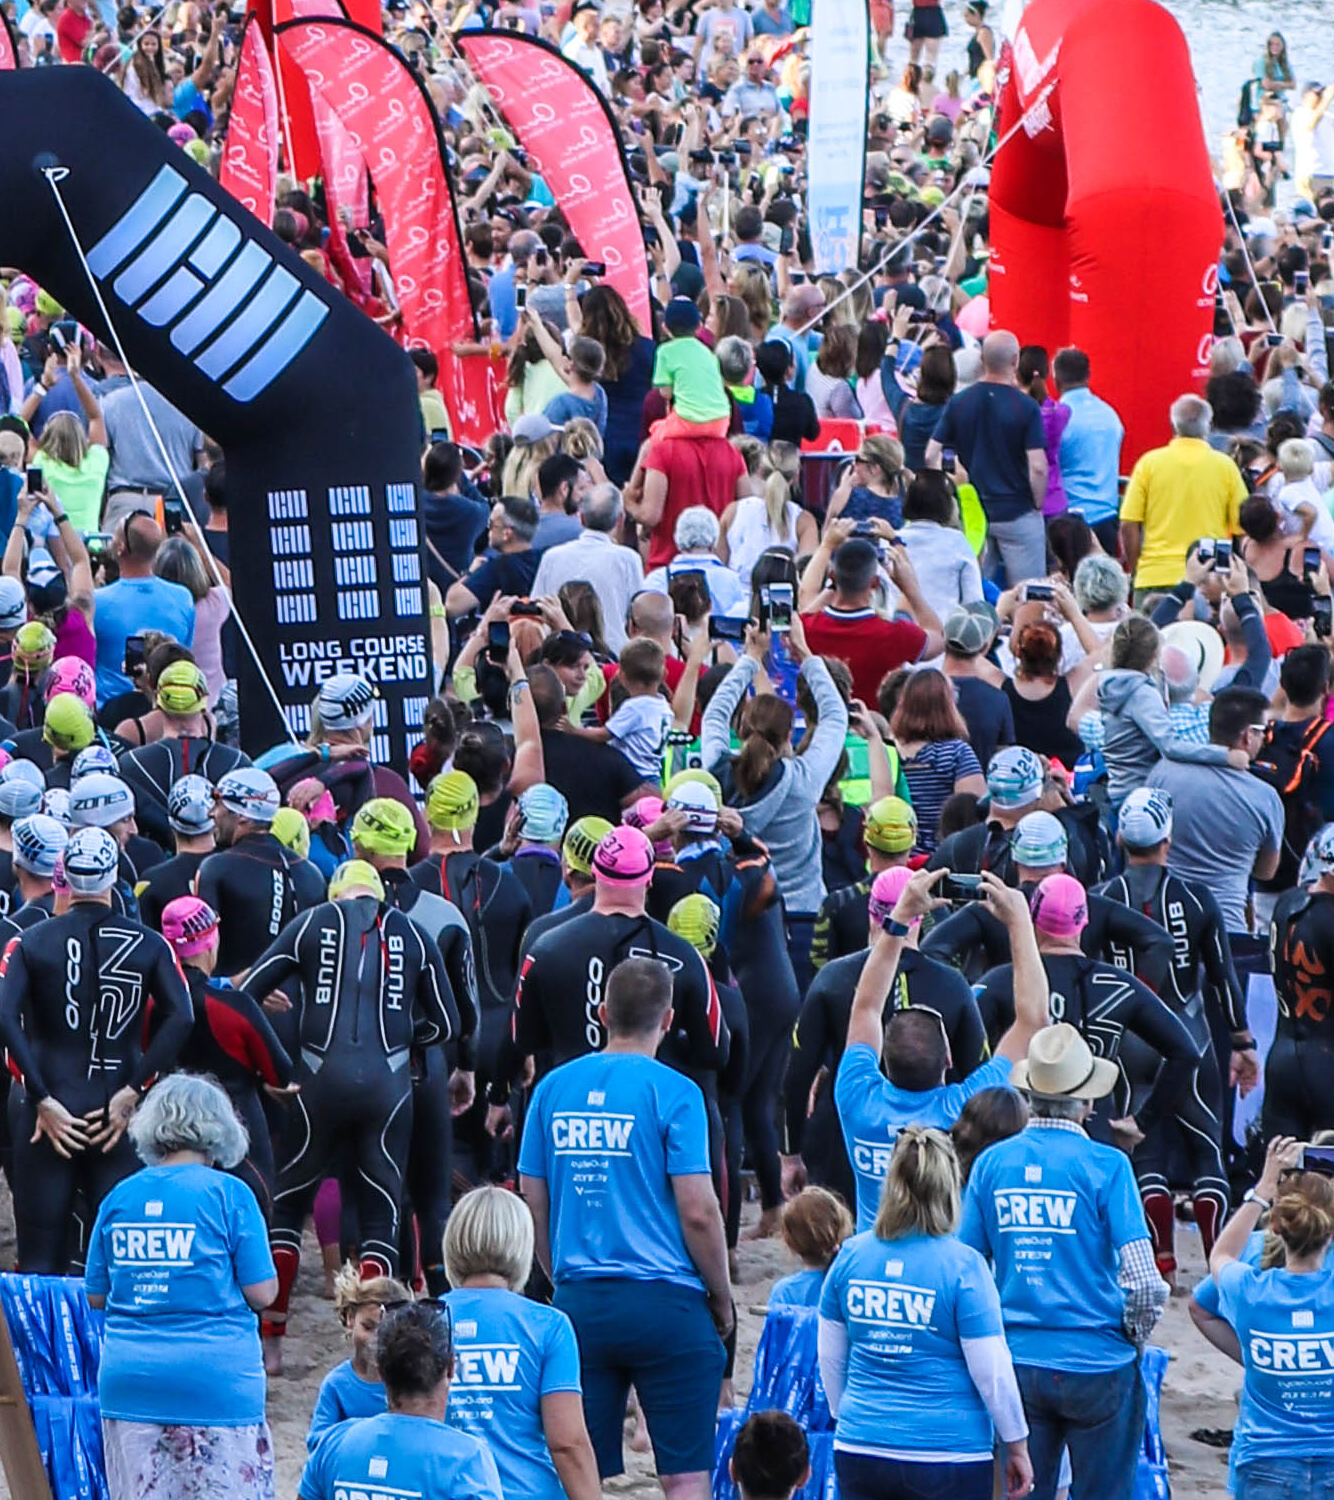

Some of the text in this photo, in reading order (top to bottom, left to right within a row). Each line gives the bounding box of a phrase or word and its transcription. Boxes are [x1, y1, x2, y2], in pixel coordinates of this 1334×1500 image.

[279, 634, 426, 661] LONG COURSE
[1168, 901, 1191, 970] HUUB
[64, 936, 82, 1031] orca
[315, 927, 337, 1005] HUUB
[386, 935, 405, 1011] HUUB
[585, 955, 604, 1048] orca
[552, 1118, 634, 1150] CREW
[853, 1145, 891, 1175] CR
[993, 1194, 1077, 1228] CREW
[111, 1228, 196, 1260] CREW
[847, 1286, 936, 1326] CREW
